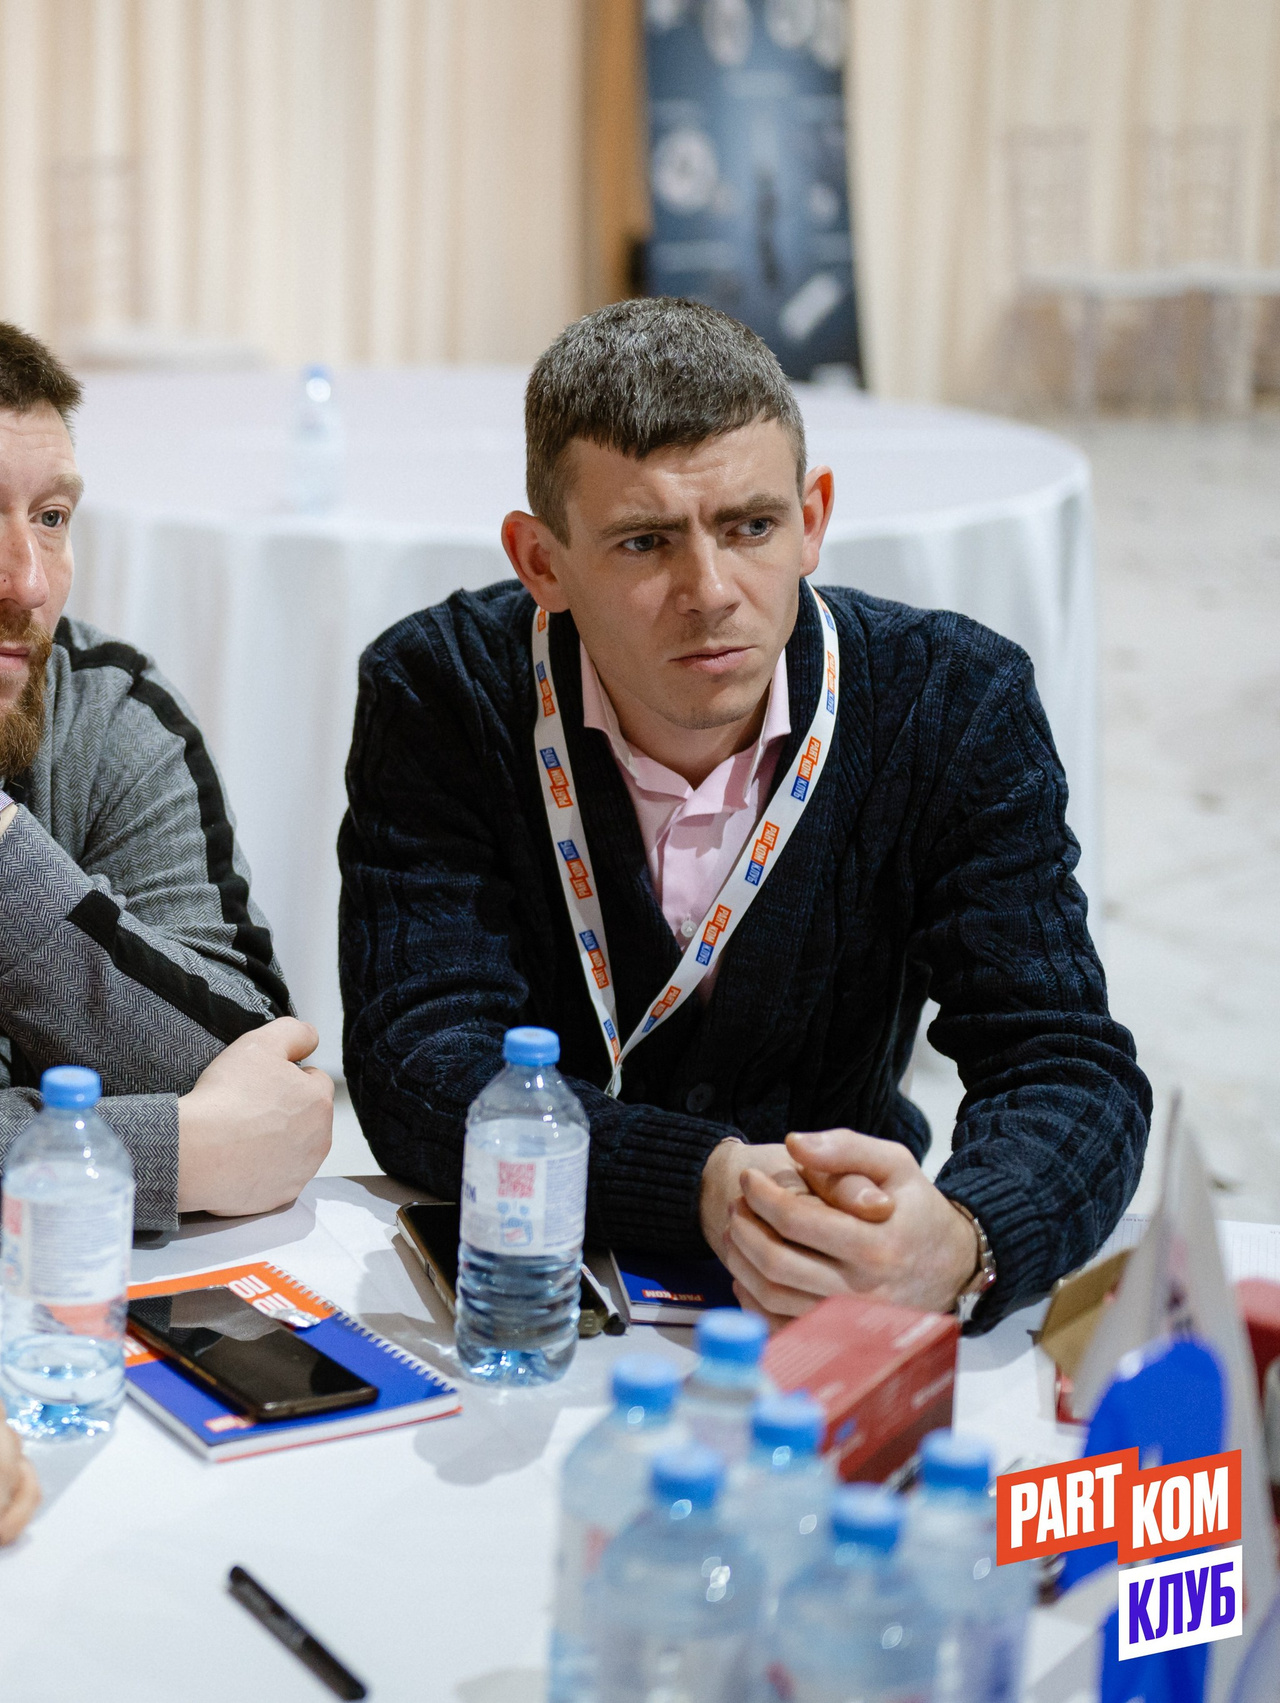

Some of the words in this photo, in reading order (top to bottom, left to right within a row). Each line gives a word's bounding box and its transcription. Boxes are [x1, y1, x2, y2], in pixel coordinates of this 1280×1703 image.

[808, 737, 820, 763] PART
[799, 756, 813, 780] KOM
[792, 777, 808, 801] КЛУБ
[762, 823, 778, 849] PART
[752, 841, 768, 865] KOM
[747, 863, 763, 885] КЛУБ
[572, 877, 592, 898] PART
[714, 906, 730, 931] PART
[703, 923, 719, 945] KOM
[697, 942, 714, 965] КЛУБ
[644, 1290, 672, 1299] KOM
